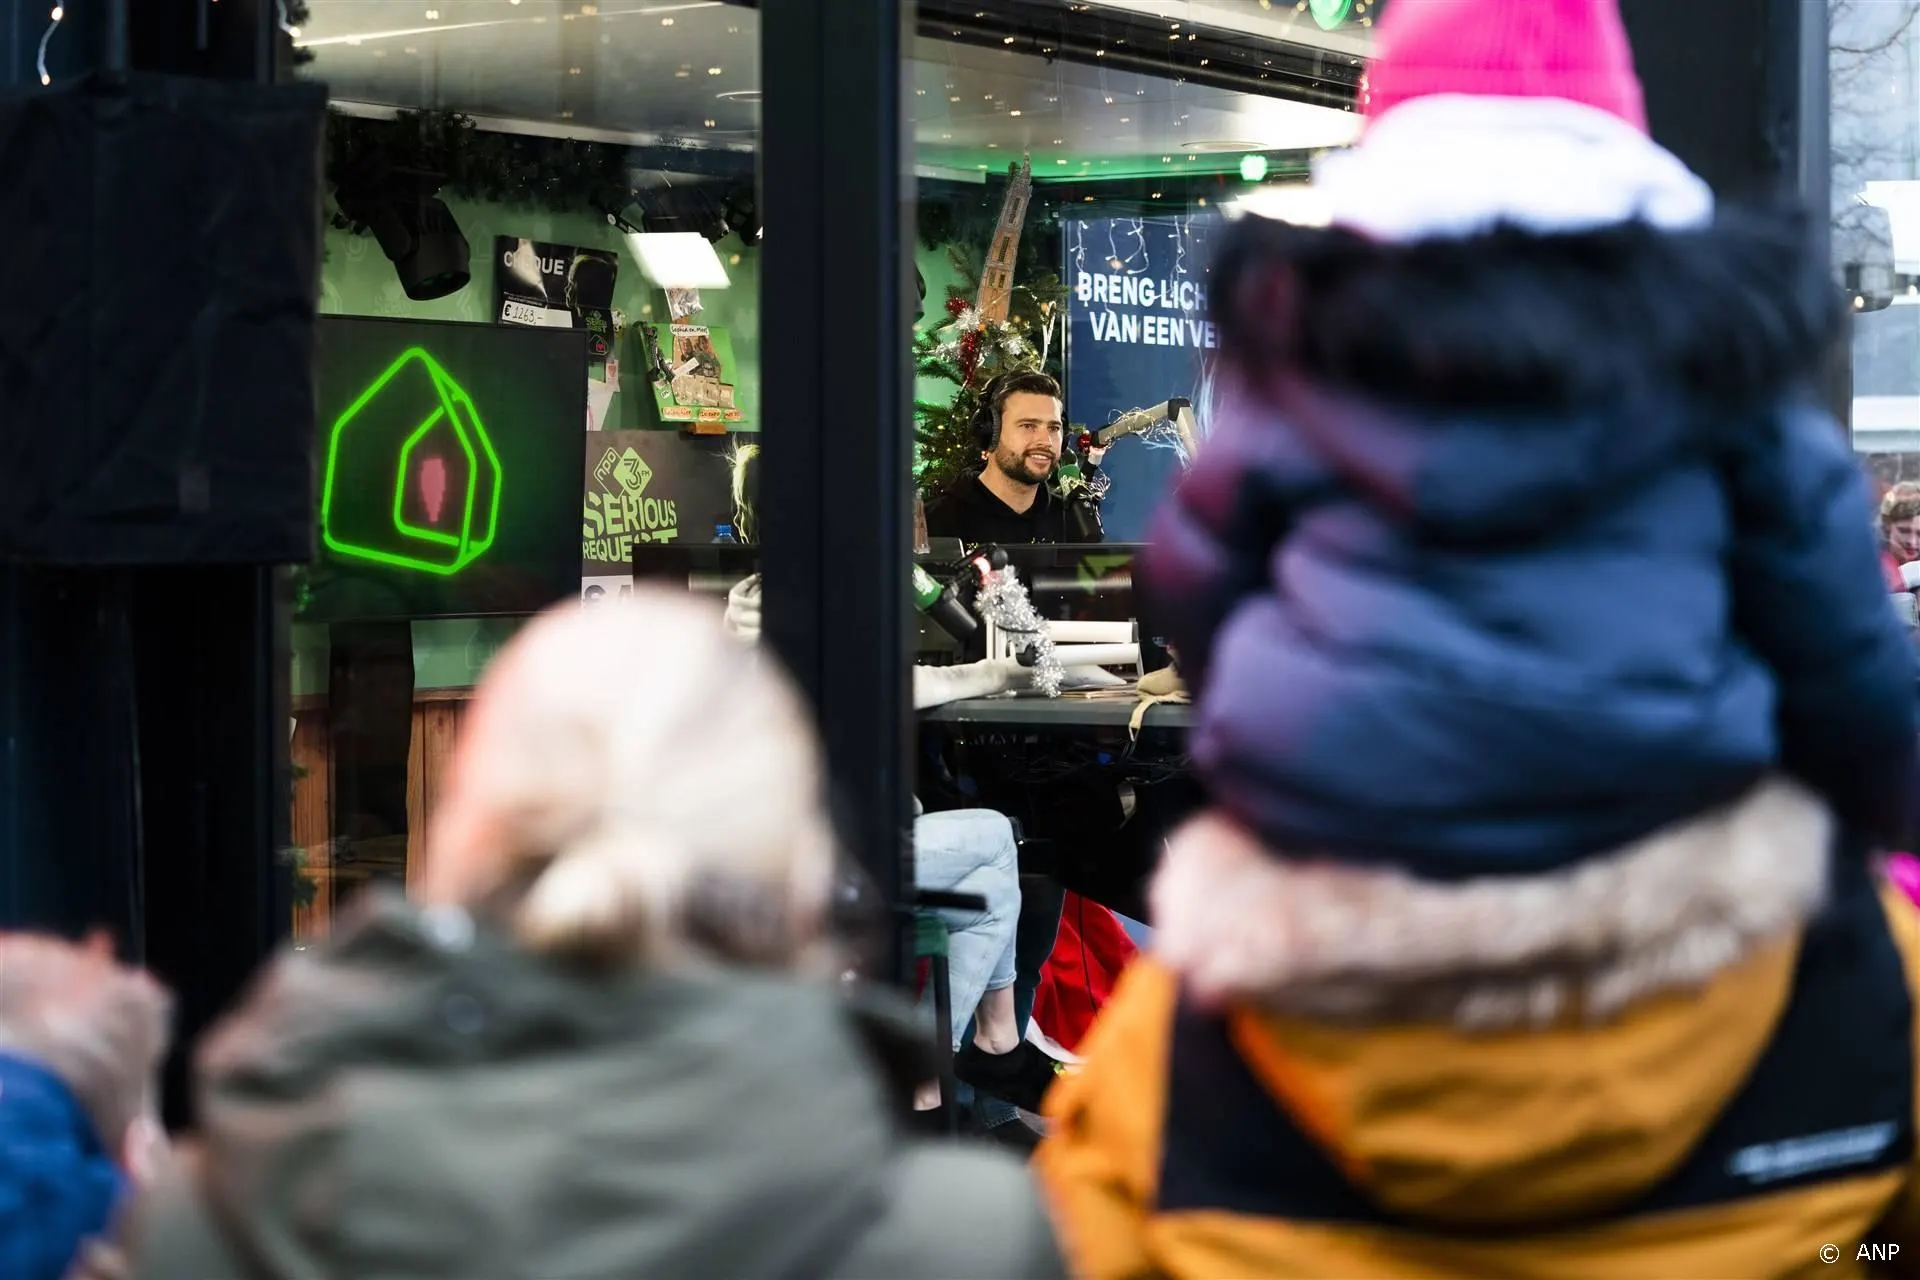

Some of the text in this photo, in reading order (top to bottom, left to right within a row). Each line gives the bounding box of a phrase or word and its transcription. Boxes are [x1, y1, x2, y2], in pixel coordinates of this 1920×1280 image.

[503, 251, 564, 275] CQUE
[1078, 272, 1154, 307] BRENG
[1089, 311, 1221, 349] VAN EEN VE
[597, 451, 617, 481] npo
[583, 491, 678, 540] SERIOUS
